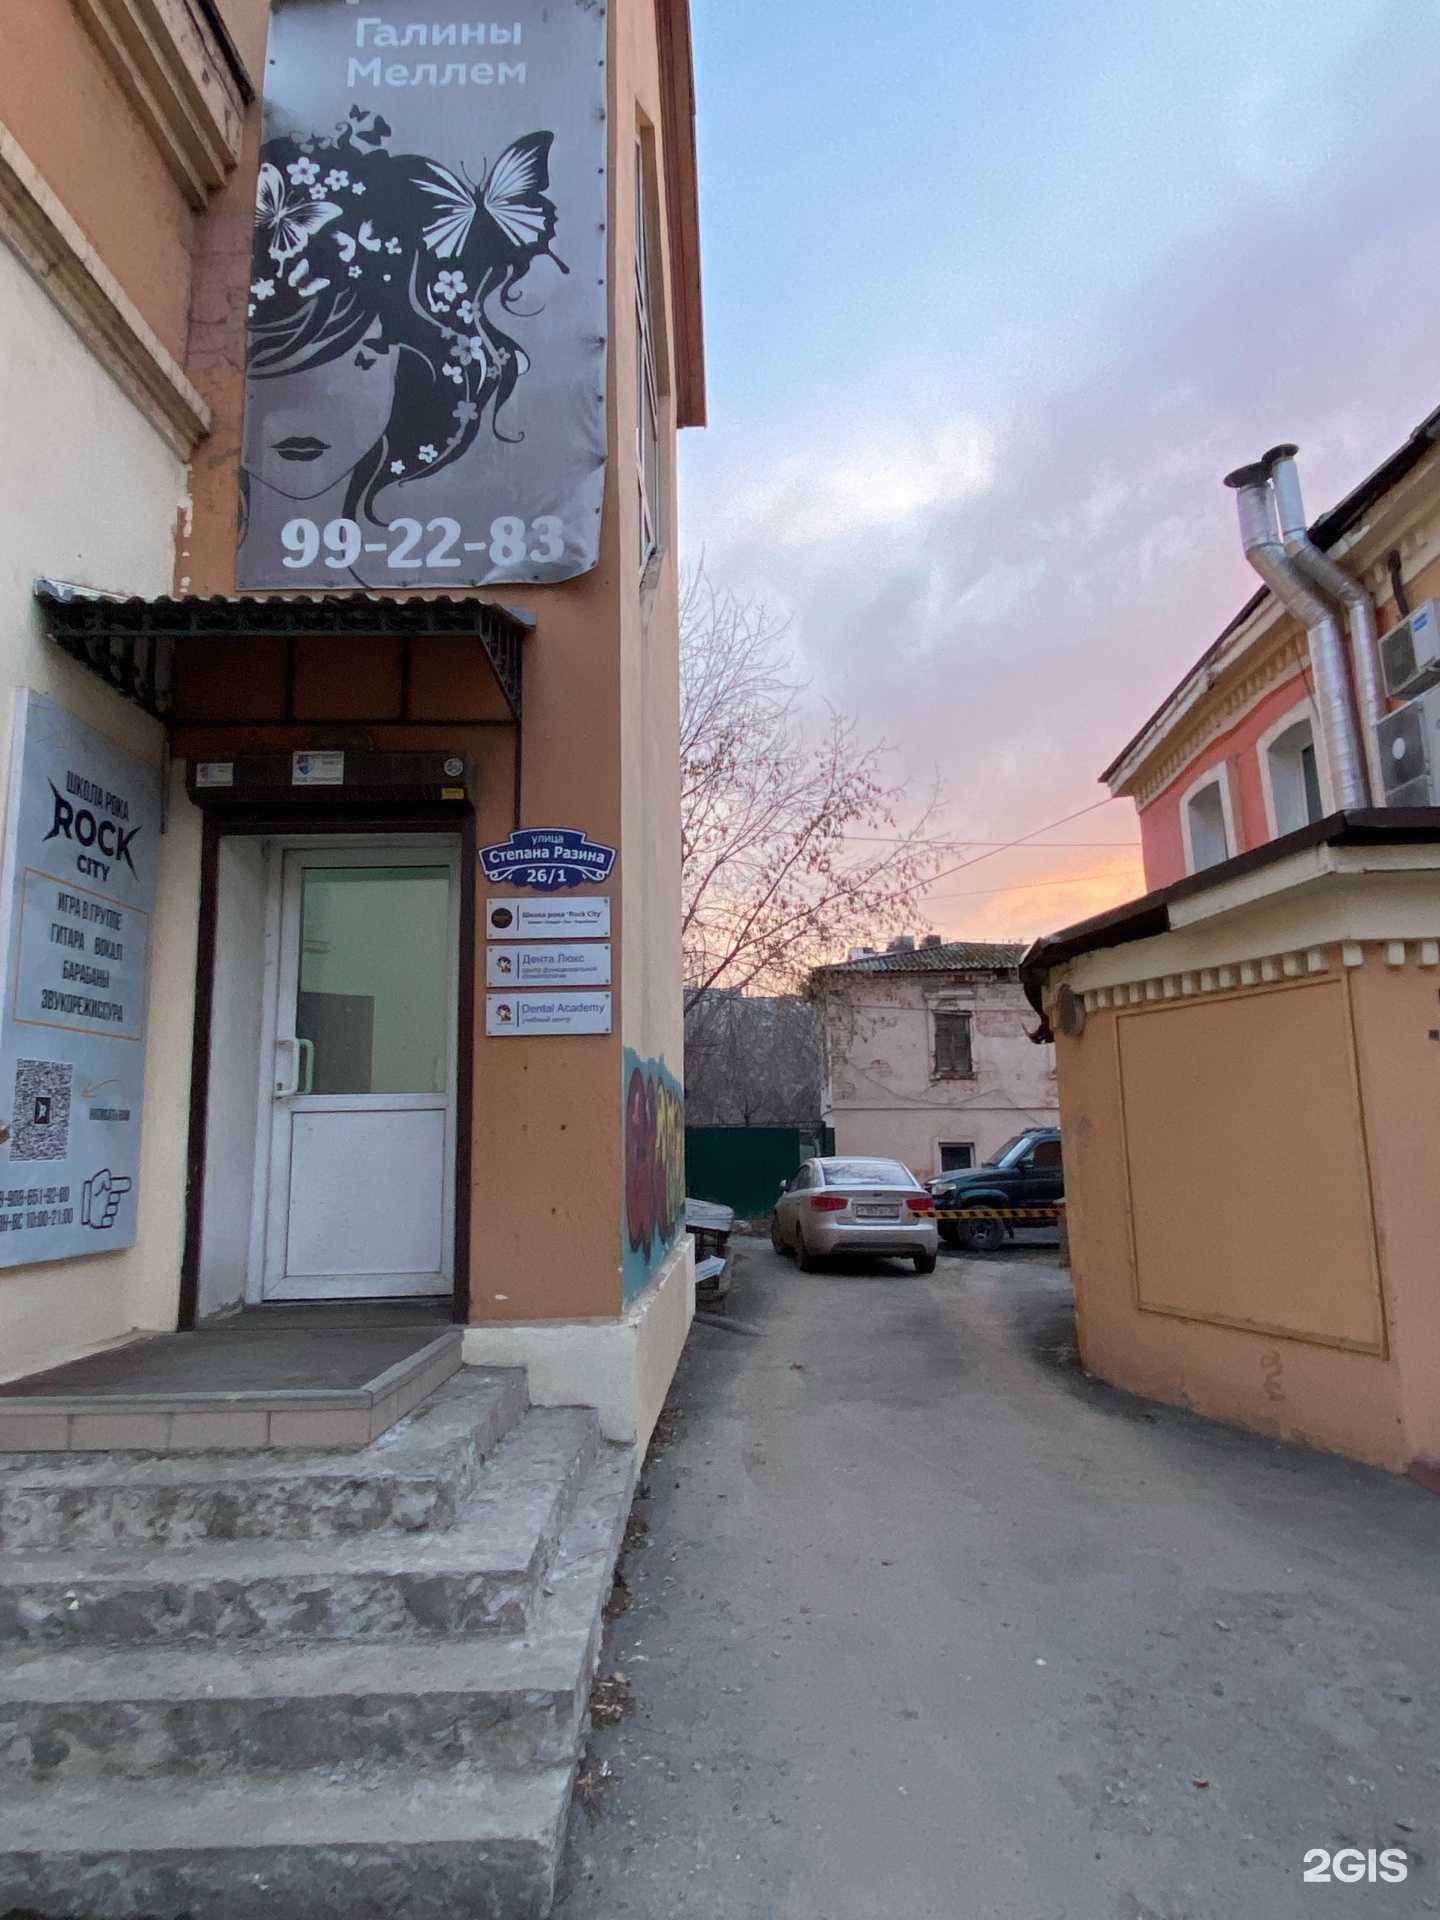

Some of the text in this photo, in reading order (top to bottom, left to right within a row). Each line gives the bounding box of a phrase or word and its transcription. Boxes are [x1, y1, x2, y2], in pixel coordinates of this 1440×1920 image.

[355, 17, 522, 48] Галины
[347, 57, 527, 88] Меллем
[281, 515, 565, 569] 99-22-83
[66, 770, 130, 821] ШКОЛА РОКА
[43, 777, 143, 881] ROCK
[531, 834, 564, 845] улица
[76, 854, 110, 882] CITY
[489, 846, 605, 864] Степана Разина
[527, 868, 567, 884] 26/1
[57, 891, 81, 917] ИГРА
[89, 903, 122, 931] ГРУППЕ
[50, 922, 123, 961] ГИТАРА ВОКАЛ
[63, 959, 110, 989] БАРАБАНЫ
[522, 953, 584, 965] Дента Люкс
[41, 988, 124, 1023] ЗВУКОРЕЖИССУРА
[522, 1002, 606, 1015] Dental Academy
